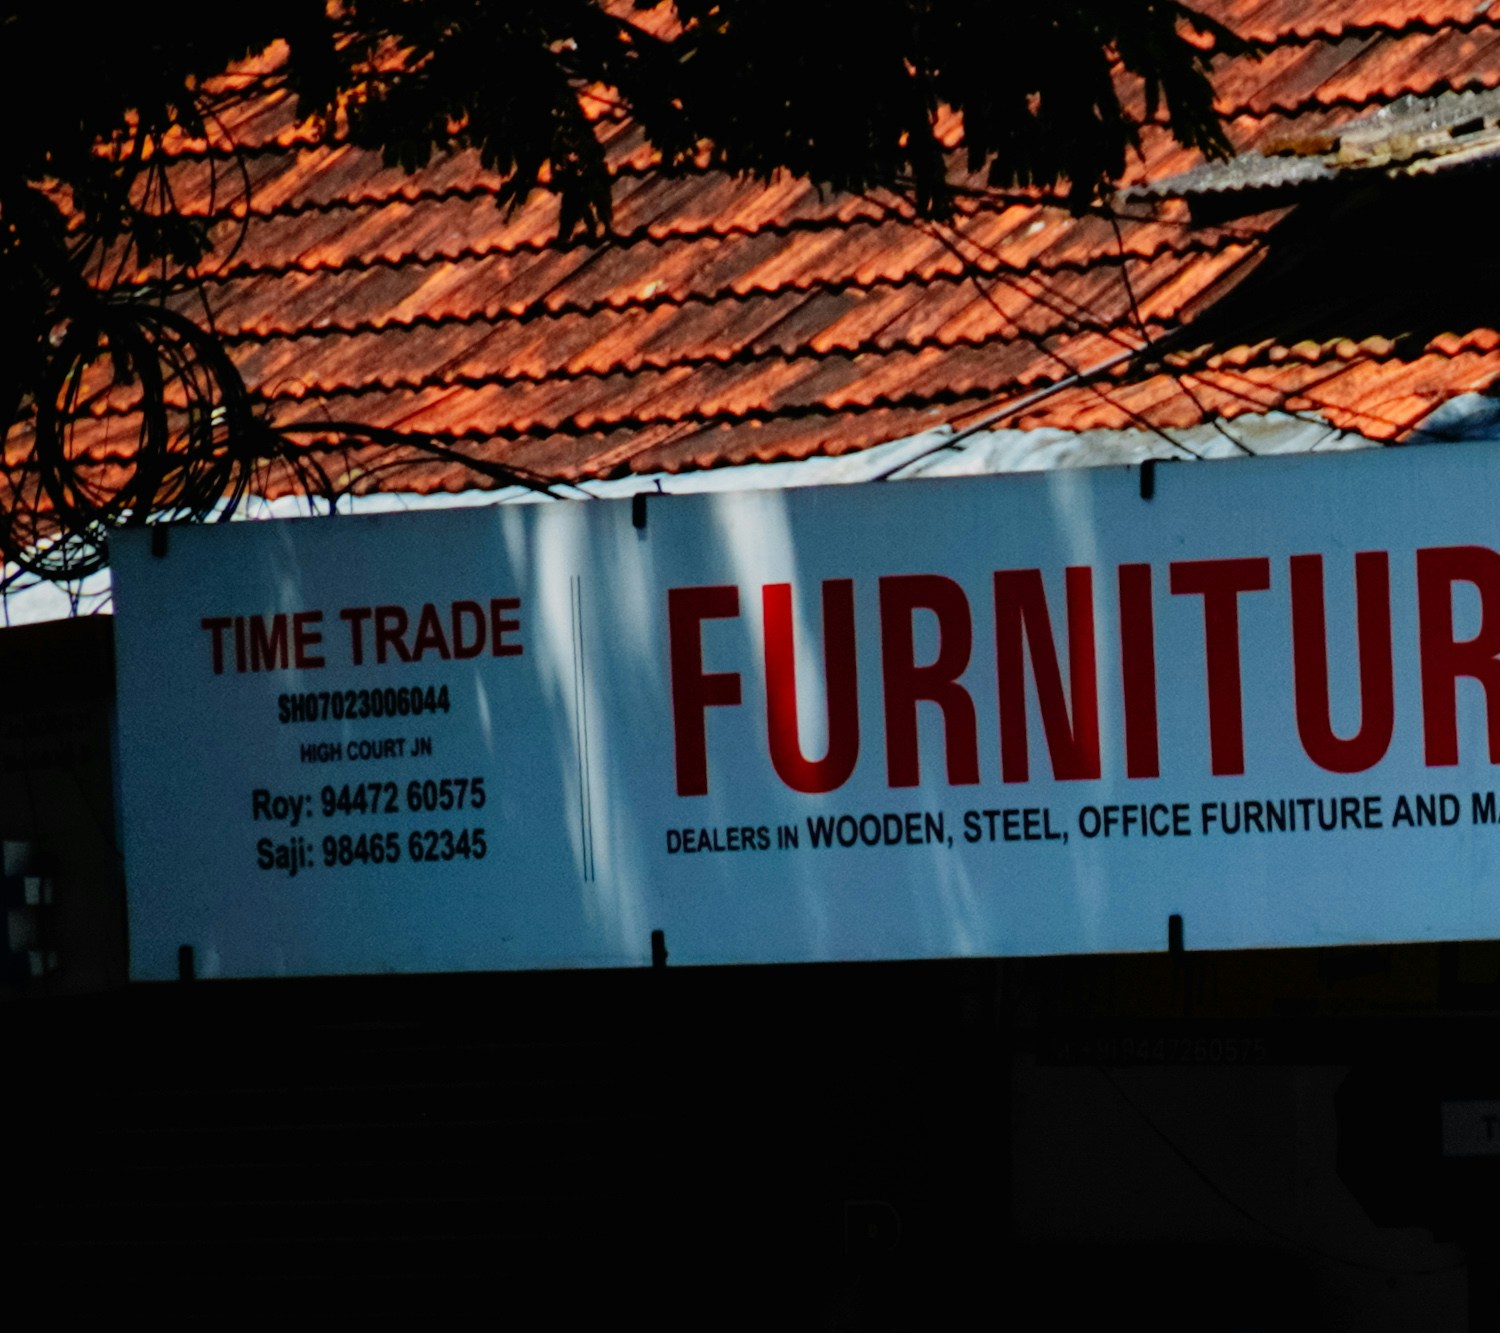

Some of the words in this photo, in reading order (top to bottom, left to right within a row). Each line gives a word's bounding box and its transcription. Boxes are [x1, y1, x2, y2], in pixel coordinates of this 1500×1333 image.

[200, 609, 326, 676] TIME
[339, 597, 524, 666] TRADE
[278, 684, 451, 724] SH07023006044
[300, 742, 343, 763] HIGH
[346, 737, 406, 761] COURT
[410, 737, 432, 757] JN
[252, 788, 313, 825] Roy:
[320, 781, 399, 817] 94472
[406, 777, 486, 812] 60575
[666, 826, 771, 854] DEALERS
[777, 825, 799, 849] IN
[806, 811, 953, 849] WOODEN,
[963, 808, 1068, 845] STEEL,
[1078, 803, 1191, 839] OFFICE
[1201, 796, 1383, 835] FURNITURE
[1392, 793, 1460, 828] AND
[256, 836, 314, 878] Saji:
[322, 832, 401, 868] 98465
[408, 828, 487, 863] 62345
